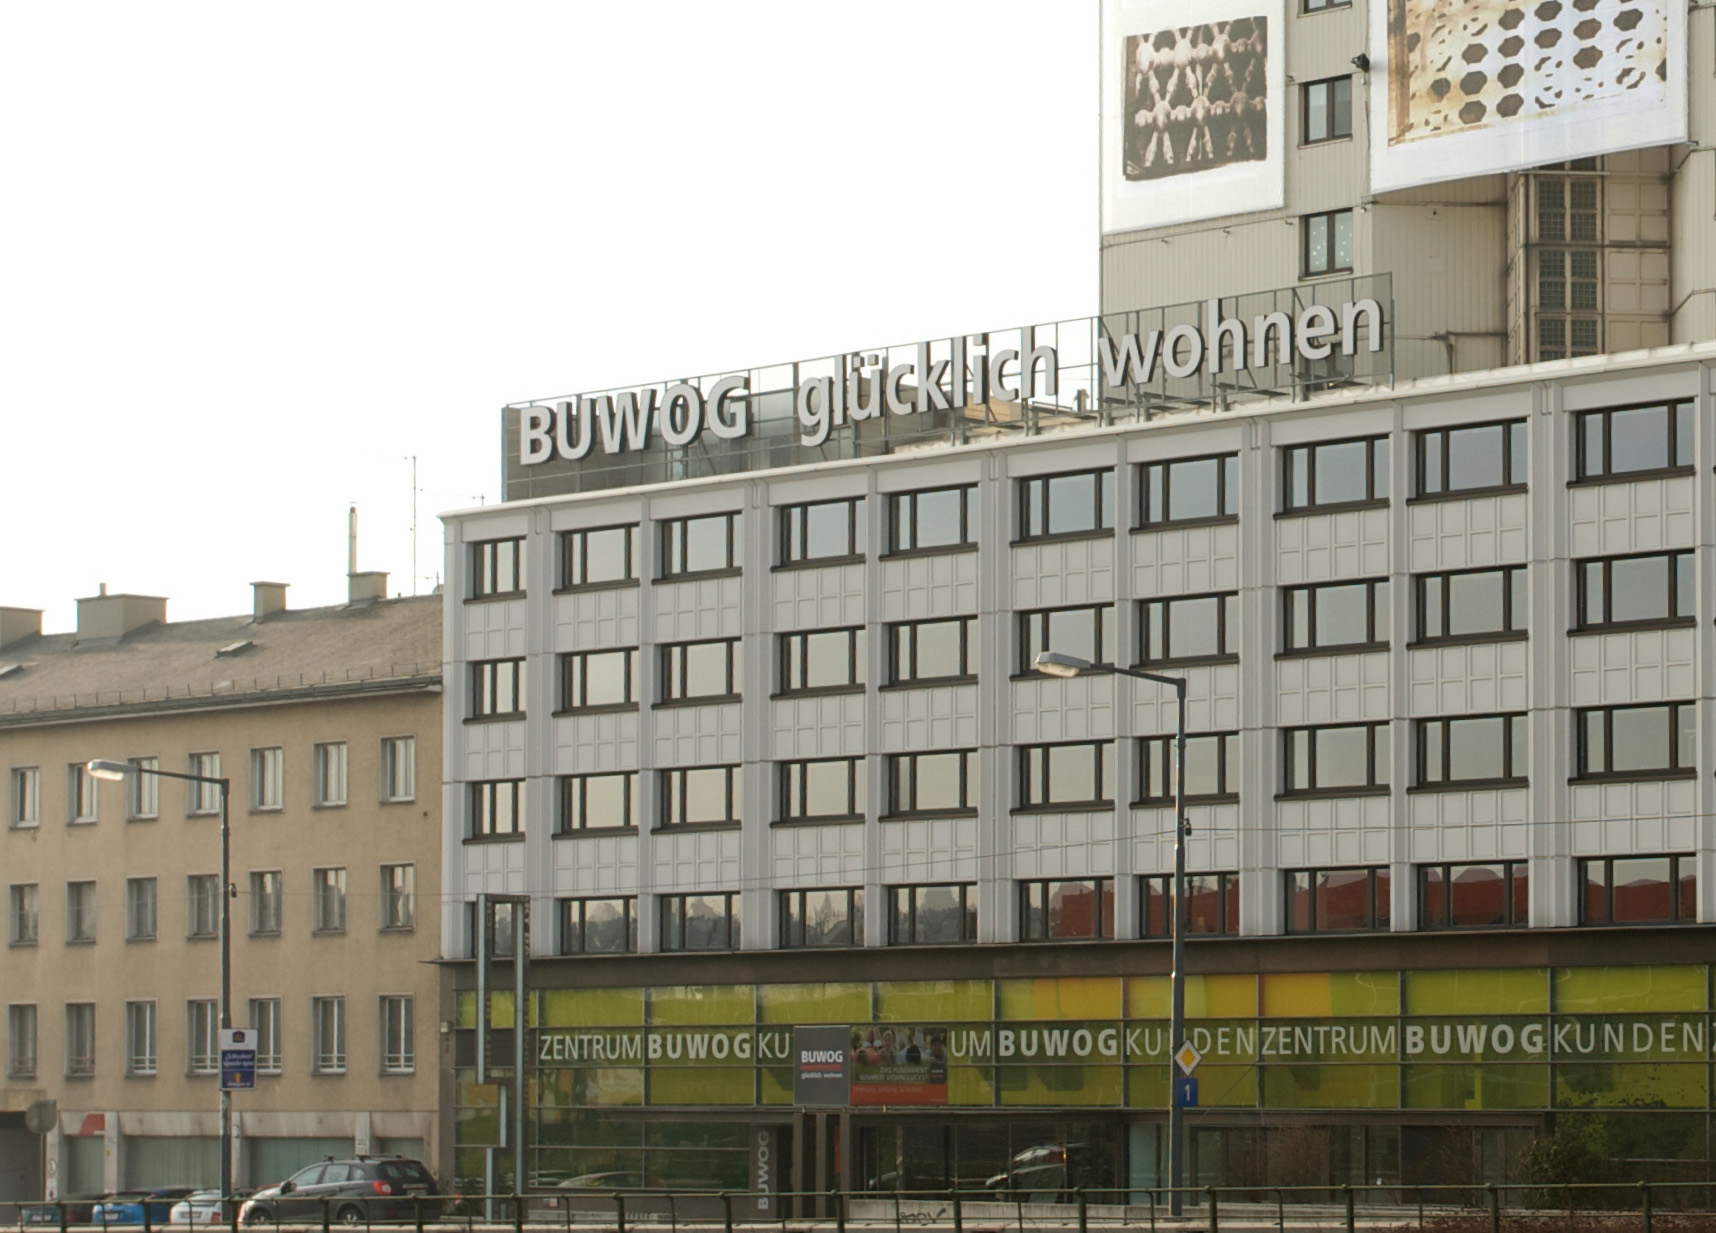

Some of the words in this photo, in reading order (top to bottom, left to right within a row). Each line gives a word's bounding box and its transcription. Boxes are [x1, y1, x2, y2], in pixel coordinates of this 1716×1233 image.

[520, 375, 752, 465] BUWOG
[797, 325, 1058, 447] glücklich
[1098, 298, 1384, 387] wohnen
[540, 1034, 641, 1060] ZENTRUM
[647, 1033, 751, 1059] BUWOG
[999, 1028, 1118, 1057] BUWOG
[1261, 1025, 1396, 1055] ZENTRUM
[1406, 1023, 1544, 1055] BUWOG
[1553, 1022, 1703, 1053] KUNDEN
[801, 1050, 843, 1063] BUWOG
[1184, 1083, 1191, 1101] 1
